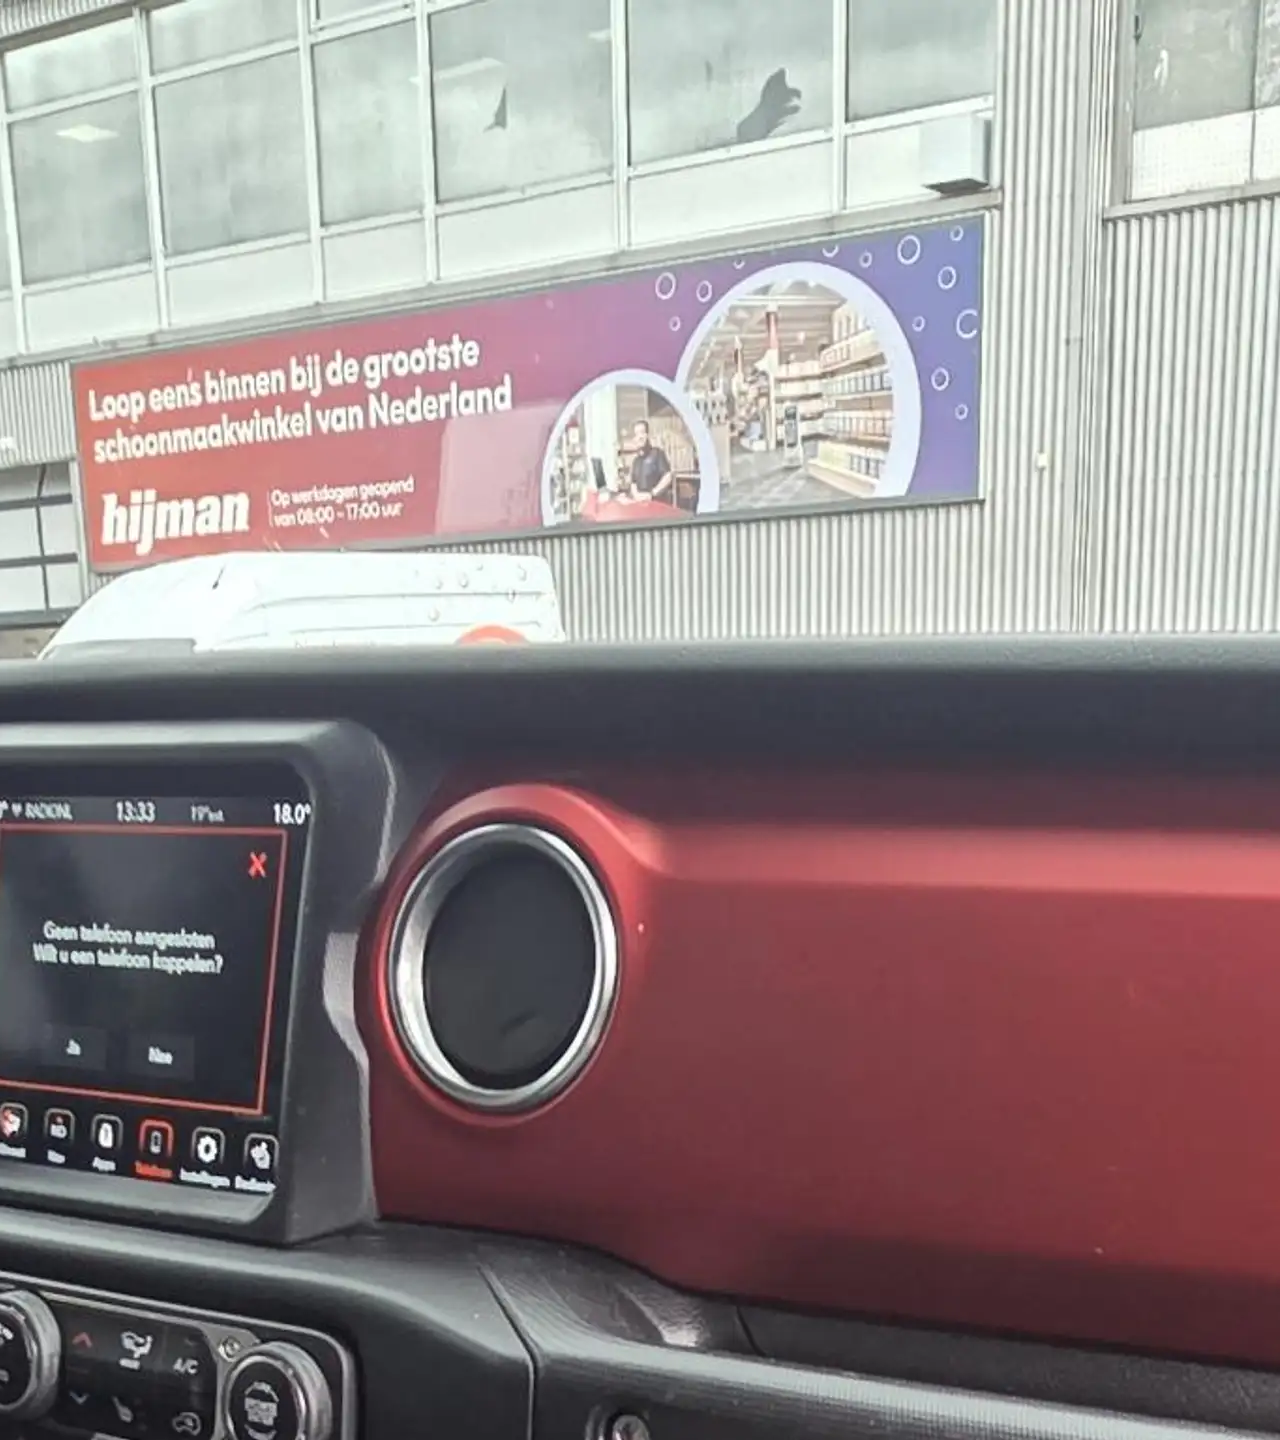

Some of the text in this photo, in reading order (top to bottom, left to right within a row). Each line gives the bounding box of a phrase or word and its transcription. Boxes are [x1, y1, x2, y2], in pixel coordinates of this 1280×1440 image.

[89, 334, 480, 422] Loop eens binnen bij de grootste
[94, 374, 512, 463] schoonmaakwinkel van Nederland
[271, 474, 415, 508] Op werkdagen geopend
[101, 489, 250, 556] hijman
[273, 512, 296, 527] van
[345, 501, 380, 520] 17:00
[381, 502, 405, 517] uur
[116, 799, 156, 824] 13:33
[43, 919, 216, 950] Geen telefoon aangesloten
[32, 941, 224, 976] Wilt u een telefoon koppelen?
[173, 1357, 199, 1375] A/C
